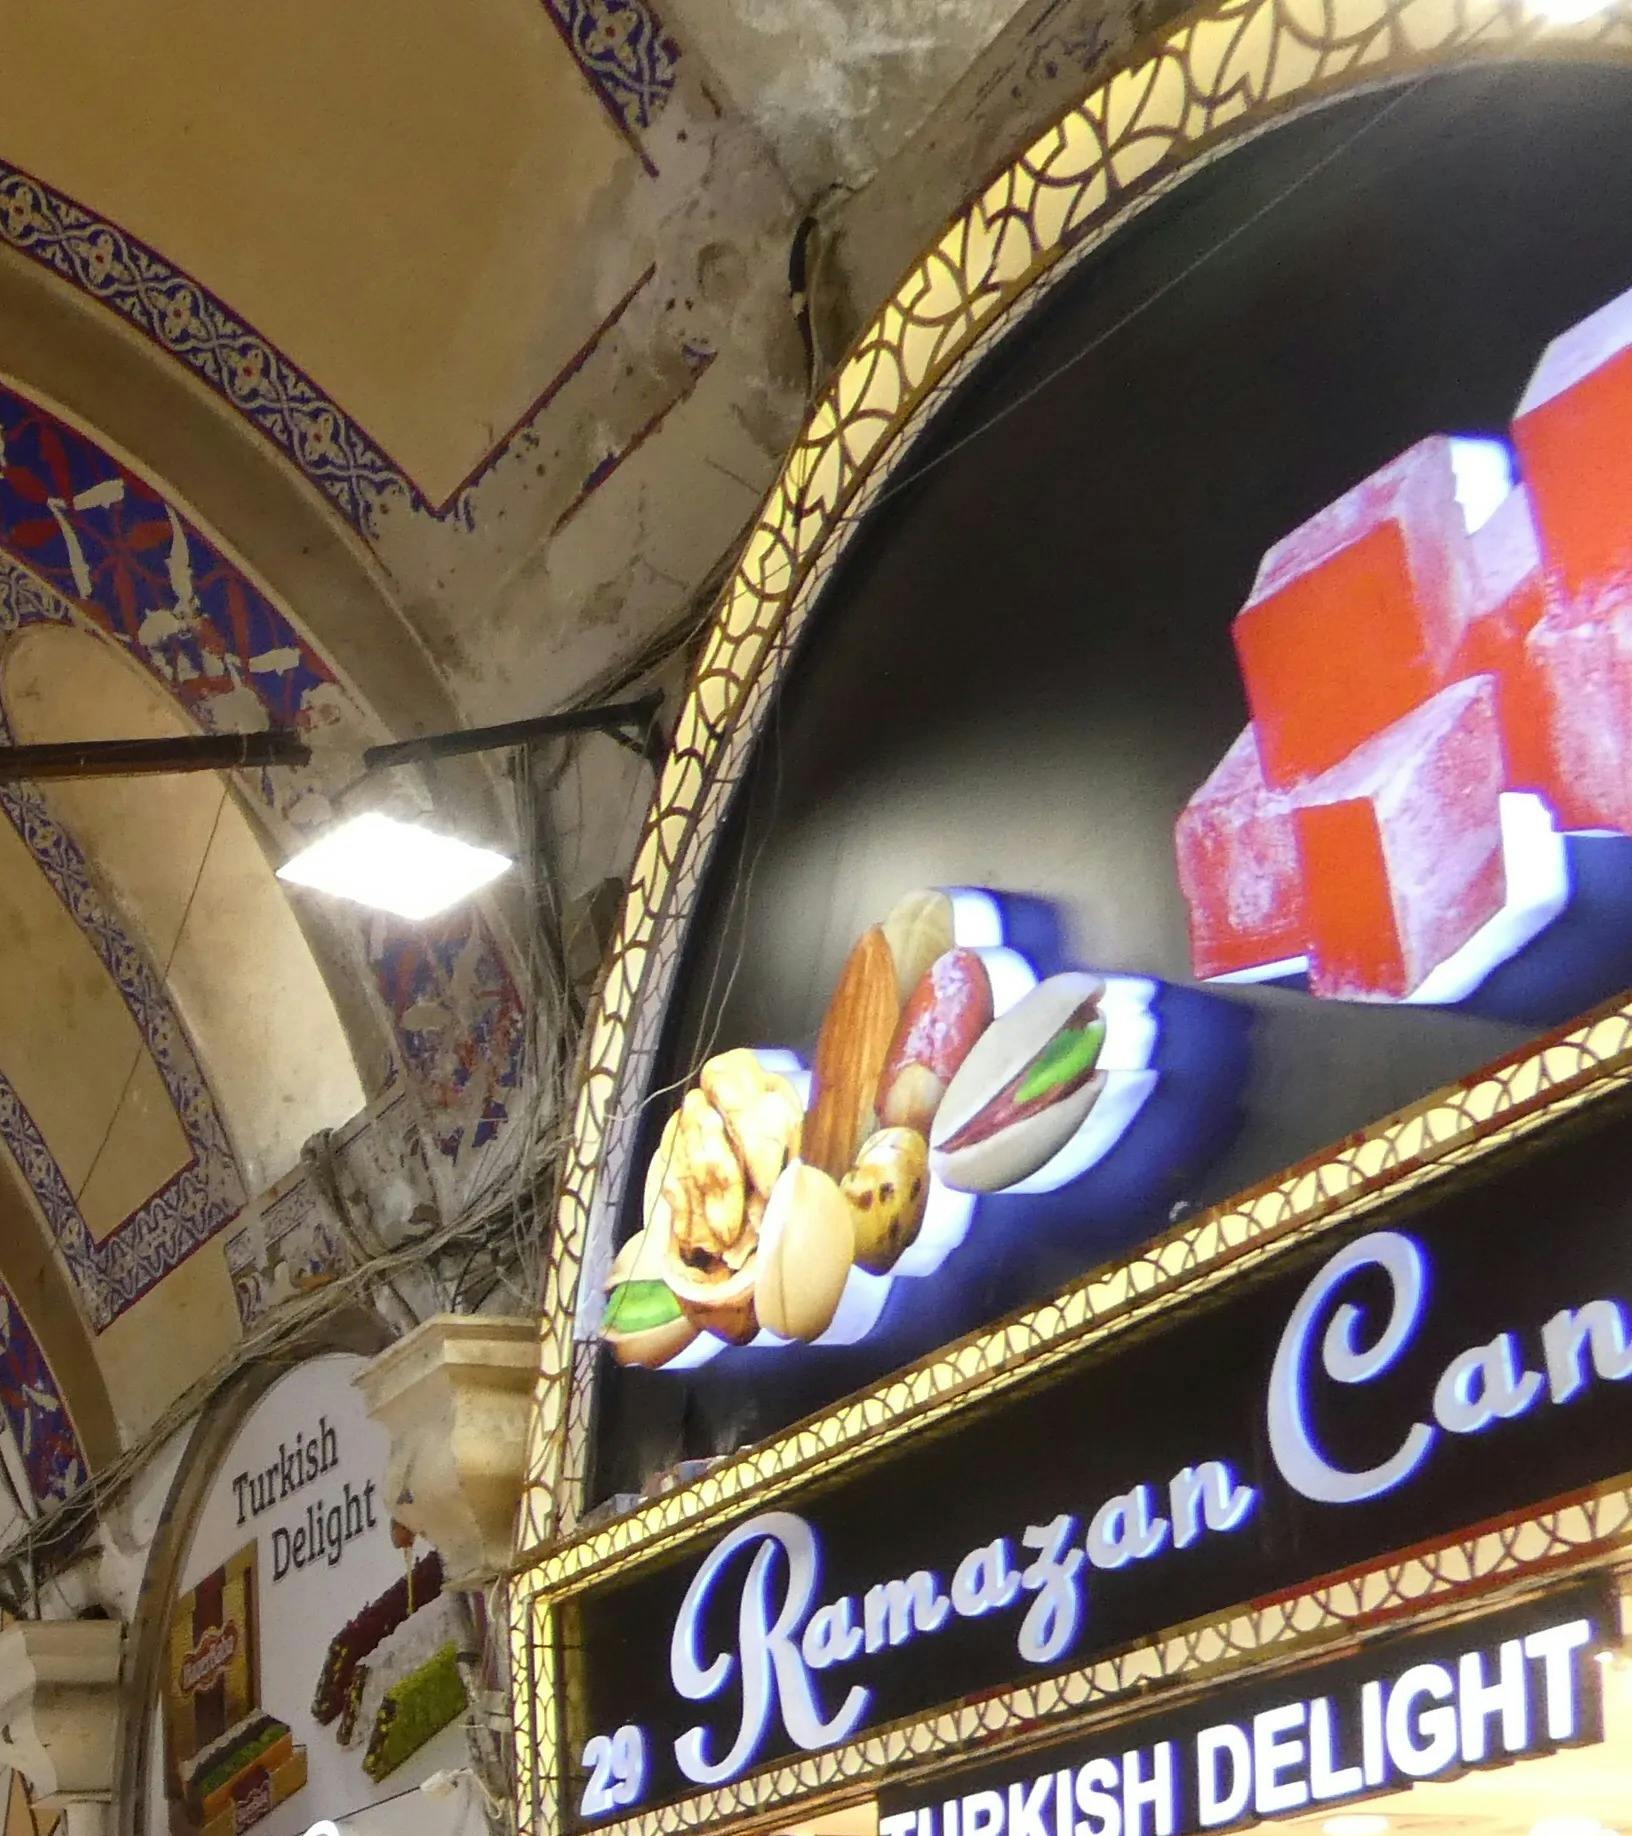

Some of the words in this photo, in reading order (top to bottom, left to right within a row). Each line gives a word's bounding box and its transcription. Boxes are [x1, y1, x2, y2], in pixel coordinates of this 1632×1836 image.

[233, 1415, 338, 1525] Turkish
[670, 1458, 1257, 1785] Ramazan
[1267, 1231, 1632, 1503] Can
[272, 1479, 377, 1581] Delight
[580, 1724, 646, 1818] 29
[1197, 1618, 1593, 1827] DELIGHT
